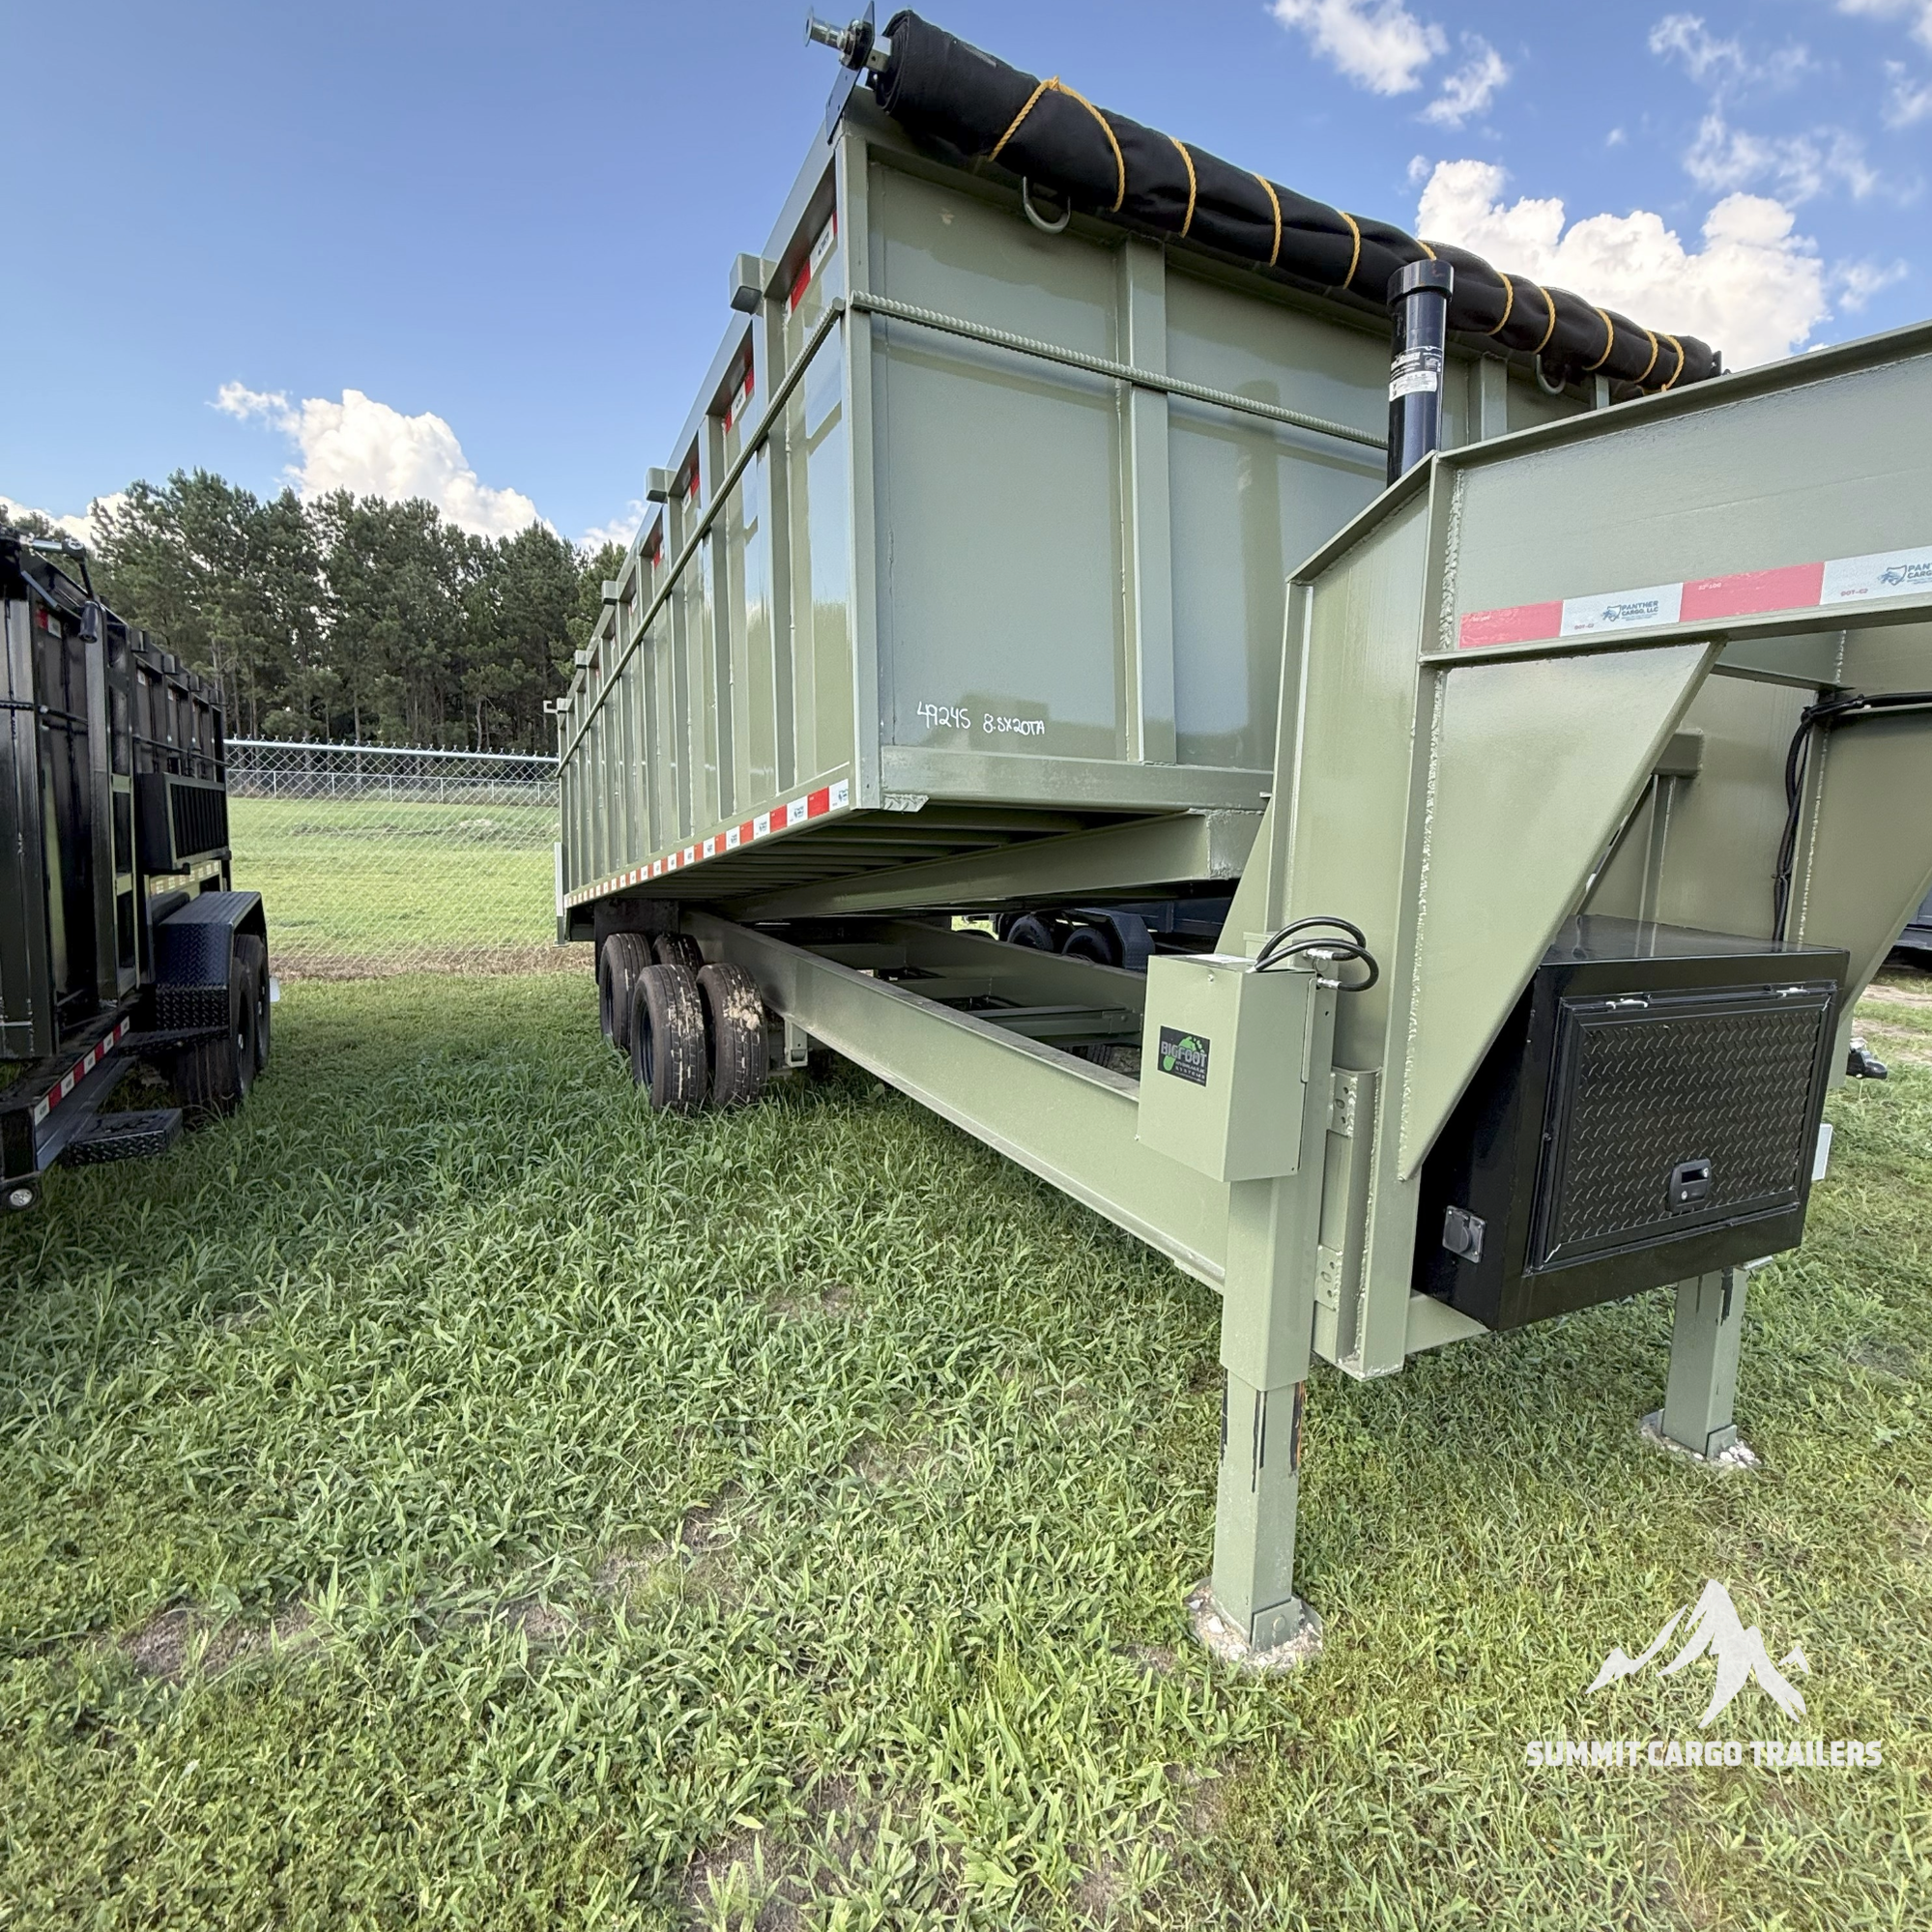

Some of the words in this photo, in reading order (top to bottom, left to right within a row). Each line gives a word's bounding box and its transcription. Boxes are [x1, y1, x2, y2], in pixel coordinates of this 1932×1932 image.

[1840, 588, 1869, 597] DOT-C2
[1621, 600, 1658, 611] PANTHER
[1621, 608, 1646, 618] CARGO,
[1160, 1040, 1207, 1068] BIGFOOT
[1174, 1065, 1205, 1081] SYSTEMS
